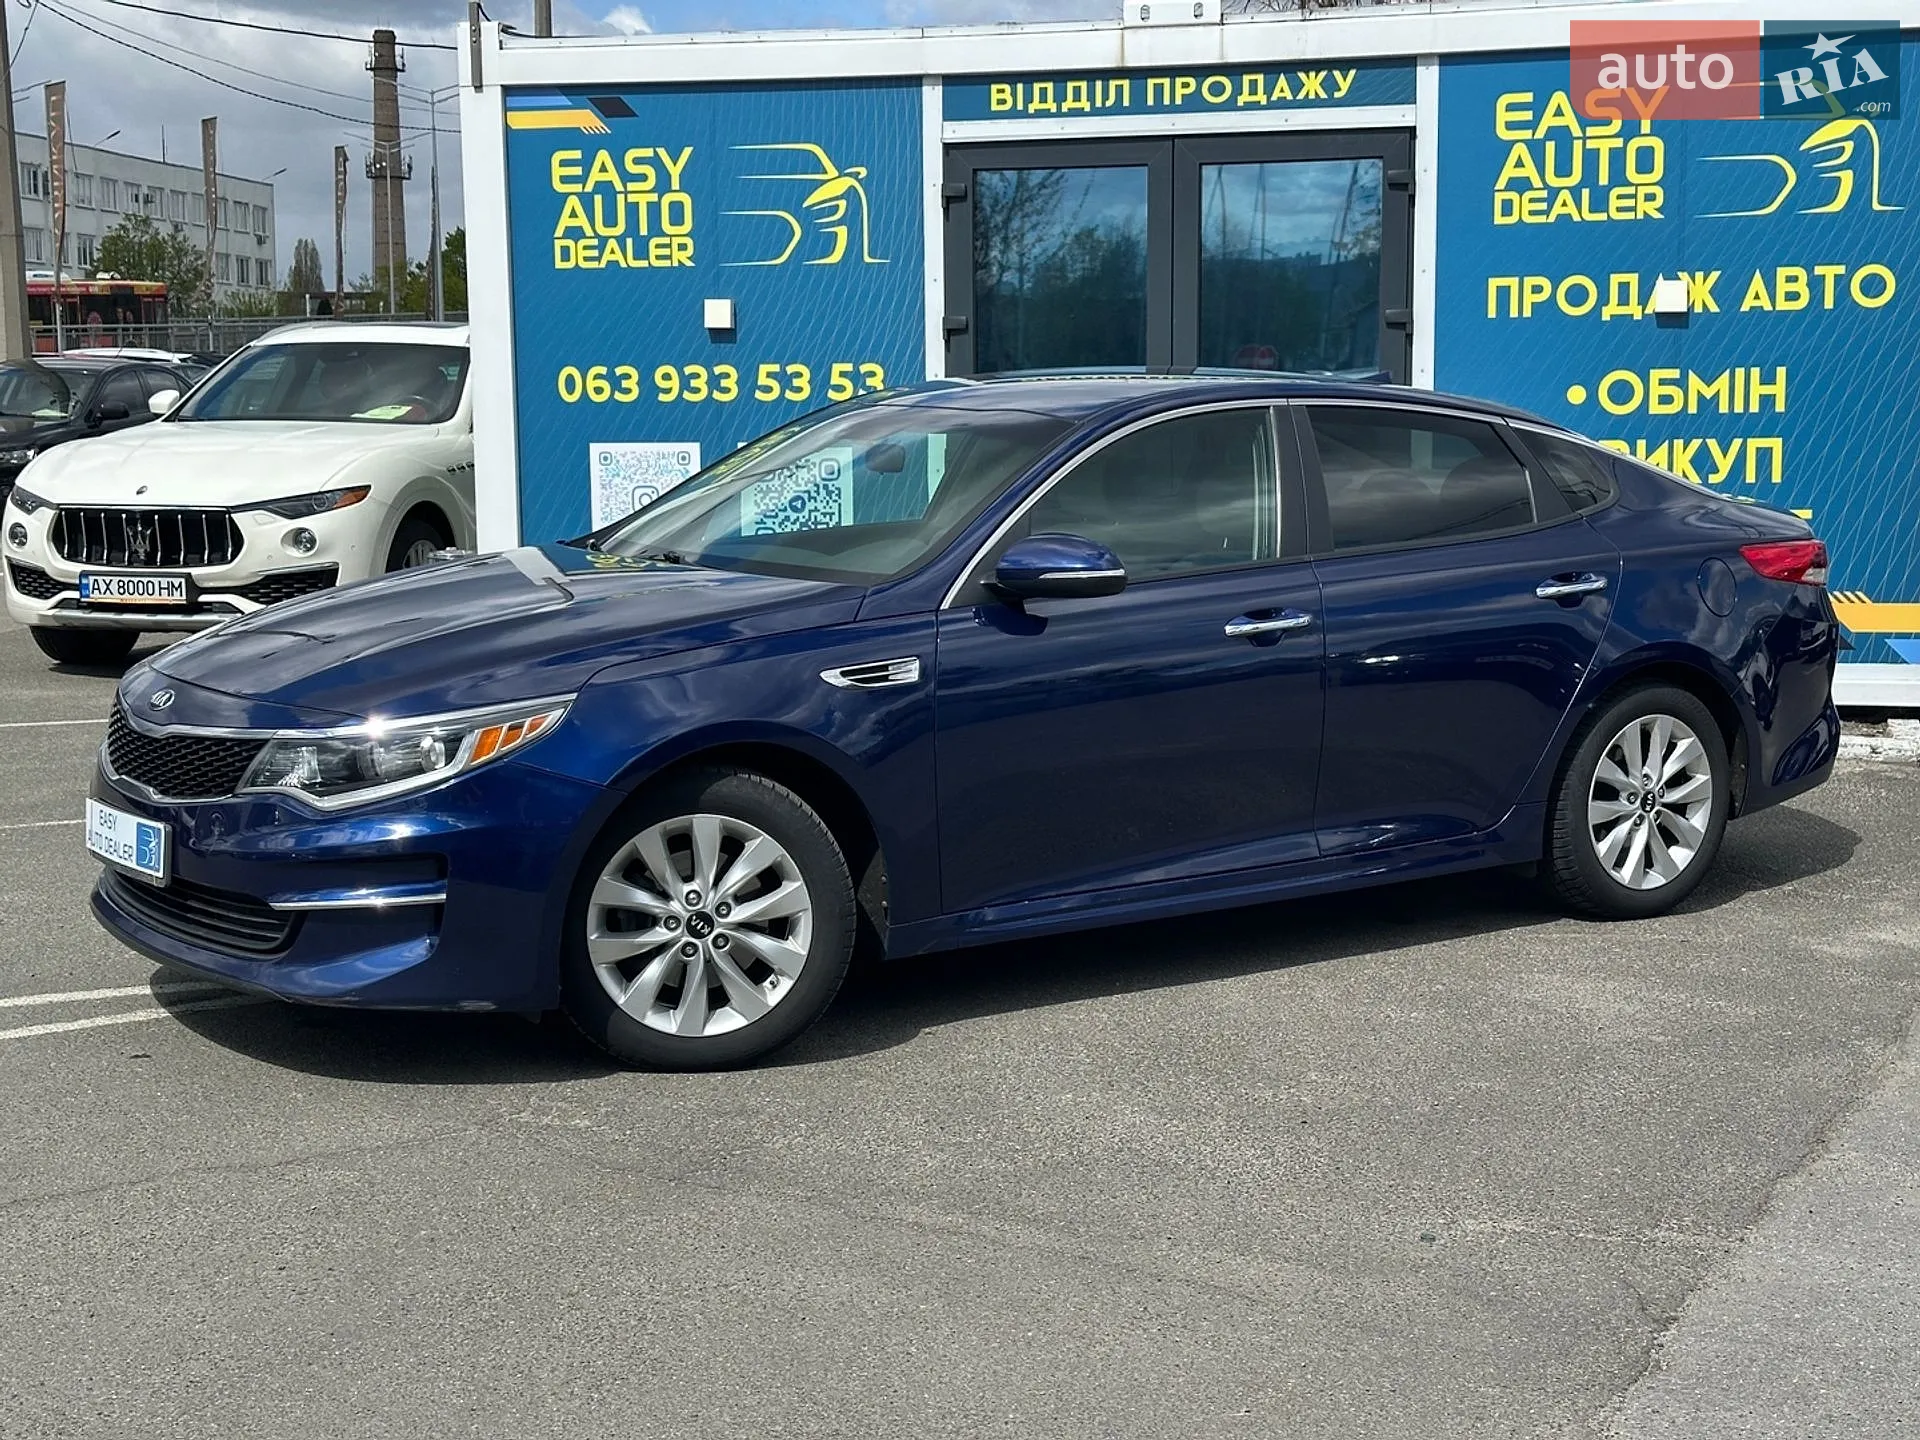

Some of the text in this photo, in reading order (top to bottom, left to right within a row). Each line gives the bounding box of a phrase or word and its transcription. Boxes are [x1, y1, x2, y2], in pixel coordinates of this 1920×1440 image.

[990, 69, 1357, 114] ВІДДІЛ ПРОДАЖУ
[1495, 85, 1670, 140] EASY
[551, 147, 694, 193] EASY
[1494, 136, 1665, 190] AUTO
[553, 192, 693, 237] AUTO
[1494, 185, 1665, 225] DEALER
[554, 236, 696, 269] DEALER
[1487, 263, 1897, 321] ПРОДЖ АВТО
[557, 362, 885, 402] 063 933 53 53
[1597, 366, 1787, 416] ОБМІН
[91, 578, 113, 595] AX
[117, 580, 155, 596] 8000
[158, 581, 183, 597] HM
[99, 809, 118, 831] EASY
[104, 835, 134, 863] DEALER
